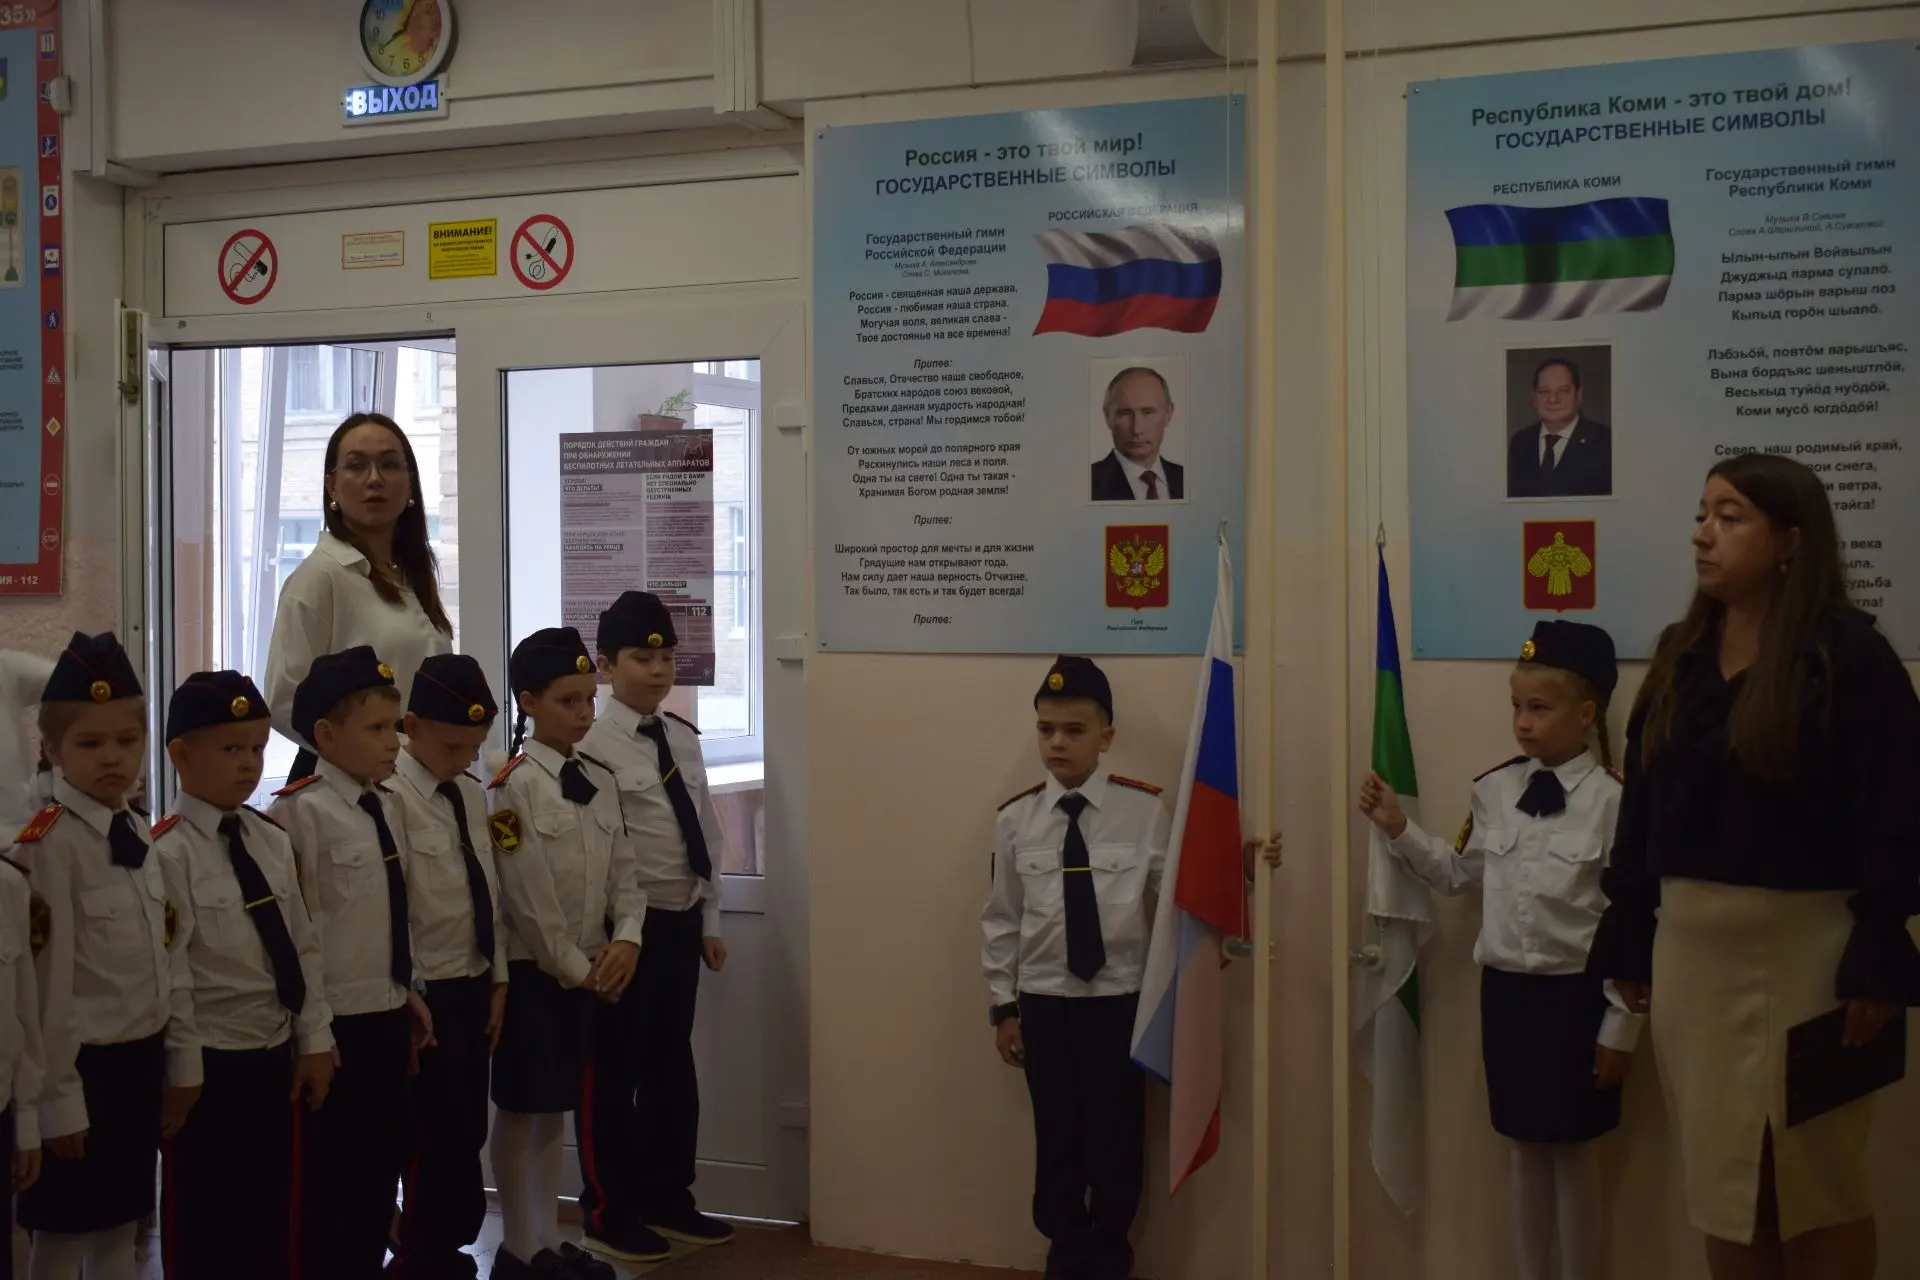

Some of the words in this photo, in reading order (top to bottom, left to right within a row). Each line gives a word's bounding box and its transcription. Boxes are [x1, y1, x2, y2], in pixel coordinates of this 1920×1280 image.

[376, 9, 385, 20] 10
[372, 27, 379, 37] 9
[378, 44, 384, 55] 8
[388, 55, 395, 66] 7
[404, 58, 410, 70] 6
[418, 53, 424, 62] 5
[352, 84, 437, 116] ВЫХОД
[1471, 100, 1601, 127] Республика
[1608, 93, 1666, 113] Коми
[1688, 91, 1726, 107] это
[1732, 82, 1788, 103] твой
[1794, 79, 1850, 101] дом!
[1495, 120, 1704, 148] ГОСУДАРСТВЕННЫЕ
[1711, 109, 1825, 130] СИМВОЛЫ
[905, 148, 977, 167] Россия
[997, 145, 1030, 161] это
[1037, 137, 1086, 158] твой
[1094, 133, 1143, 155] мир!
[876, 167, 1066, 195] ГОСУДАРСТВЕННЫЕ
[1073, 160, 1176, 181] СИМВОЛЫ
[1706, 161, 1851, 182] Государственный
[1856, 159, 1895, 171] гимн
[1492, 179, 1580, 194] РЕСПУБЛИКА
[1583, 175, 1621, 188] КОМИ
[1728, 180, 1824, 199] Республики
[1829, 175, 1872, 190] Коми
[1048, 207, 1124, 222] РОССИЙСКАЯ
[434, 226, 492, 238] ВНИМАНИЕ!
[866, 228, 972, 246] Государственный
[975, 228, 1005, 238] гимн
[864, 246, 934, 260] Российской
[937, 242, 1006, 257] Федерации
[1721, 248, 1810, 263] Ылын-ылын
[1813, 243, 1892, 258] Войвылын
[1720, 269, 1788, 284] Джуджыд
[1790, 268, 1834, 281] парма
[849, 289, 883, 301] Россия
[890, 289, 944, 299] священная
[946, 287, 971, 296] наша
[1718, 289, 1762, 304] Парма
[1765, 287, 1814, 301] шӧрын
[1818, 286, 1867, 299] варыш
[1870, 284, 1896, 294] поз
[857, 303, 892, 315] Россия
[899, 301, 944, 312] любимая
[946, 300, 971, 312] наша
[1731, 308, 1782, 321] Кыпыд
[1784, 305, 1824, 320] горӧн
[860, 317, 900, 331] Могучая
[930, 315, 970, 325] великая
[971, 314, 1000, 324] слава
[856, 332, 878, 342] Твое
[880, 332, 930, 343] достоянье
[947, 330, 964, 339] все
[966, 326, 1010, 339] времена!
[1772, 344, 1824, 357] повтӧм
[913, 358, 952, 371] Припев:
[1710, 367, 1748, 379] Вына
[1751, 364, 1812, 379] бордъяс
[889, 373, 939, 383] Отечество
[941, 373, 966, 382] наше
[854, 388, 898, 401] Братских
[900, 387, 941, 401] народов
[943, 387, 968, 396] союз
[1724, 385, 1786, 398] Веськыд
[1788, 383, 1831, 397] туйӧд
[842, 402, 889, 415] Предками
[890, 403, 925, 413] данная
[927, 399, 974, 413] мудрость
[975, 398, 1025, 411] народная!
[1736, 405, 1771, 416] Коми
[1775, 402, 1809, 417] мусӧ
[1812, 400, 1878, 415] югдӧдӧй!
[888, 415, 924, 428] страна!
[944, 415, 990, 426] гордимся
[992, 412, 1024, 422] тобой!
[564, 441, 596, 449] ПОРЯДОК
[598, 440, 634, 449] ДЕЙСТВИЙ
[635, 439, 669, 447] ГРАЖДАН
[861, 447, 896, 455] южных
[898, 443, 928, 456] морей
[944, 444, 996, 454] полярного
[998, 443, 1020, 454] края
[1764, 445, 1792, 454] наш
[1795, 440, 1862, 455] родимый
[564, 452, 577, 460] ПРИ
[578, 451, 631, 460] ОБНАРУЖЕНИИ
[564, 462, 615, 470] БЕСПИЛОТНЫХ
[616, 461, 666, 469] ЛЕТАТЕЛЬНЫХ
[667, 459, 710, 467] АППАРАТОВ
[858, 458, 920, 471] Раскинулись
[921, 459, 946, 468] наши
[949, 458, 972, 468] леса
[852, 473, 877, 485] Одна
[907, 471, 937, 484] свете!
[939, 471, 964, 483] Одна
[966, 472, 980, 481] ты
[982, 472, 1009, 480] такая
[858, 487, 904, 499] Хранимая
[907, 486, 936, 496] Богом
[939, 487, 974, 497] родная
[976, 485, 1008, 495] земля!
[1838, 481, 1882, 492] ветра,
[1833, 499, 1875, 510] тайга!
[913, 514, 952, 527] Припев:
[834, 543, 878, 555] Широкий
[880, 545, 918, 555] простор
[920, 544, 938, 554] для
[982, 544, 1002, 554] для
[1003, 544, 1034, 552] жизни
[1851, 540, 1882, 549] века
[859, 557, 906, 570] Грядущие
[907, 559, 926, 568] нам
[928, 559, 982, 569] открывают
[20, 576, 38, 585] 112
[841, 571, 860, 581] Нам
[862, 573, 884, 583] силу
[886, 572, 908, 584] дает
[910, 573, 935, 581] наша
[937, 572, 982, 584] верность
[844, 585, 860, 595] Так
[892, 587, 908, 595] так
[909, 587, 930, 595] есть
[932, 587, 939, 595] и
[940, 587, 956, 595] так
[958, 585, 986, 598] будет
[988, 585, 1024, 596] всегда!
[692, 607, 707, 616] 112
[913, 614, 952, 626] Припев:
